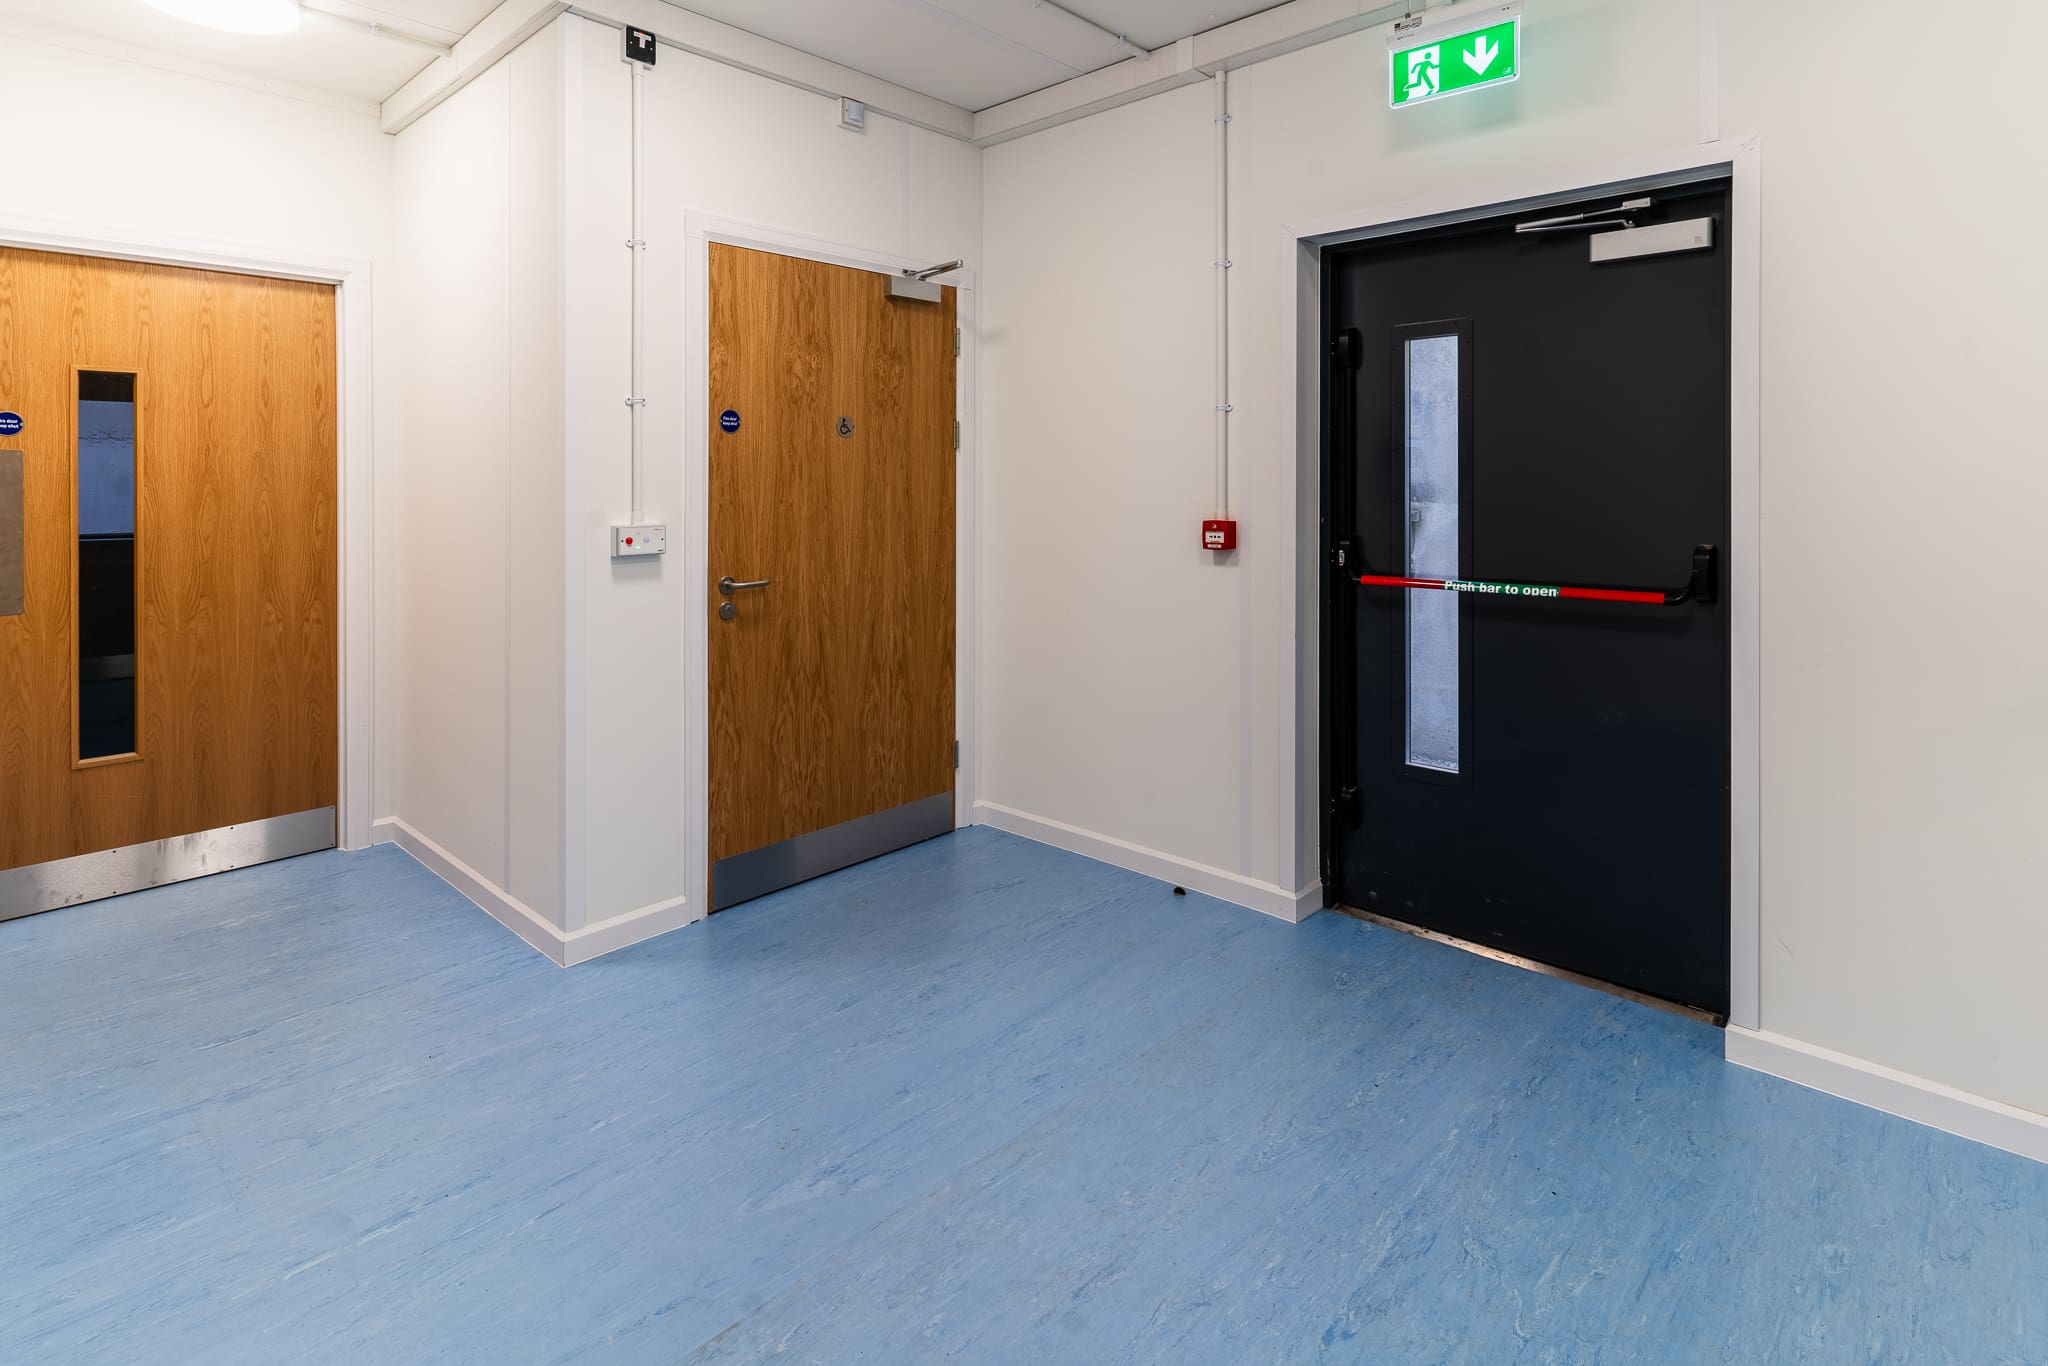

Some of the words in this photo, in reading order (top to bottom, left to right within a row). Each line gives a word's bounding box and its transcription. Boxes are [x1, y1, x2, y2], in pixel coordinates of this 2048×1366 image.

[1444, 581, 1475, 592] Push
[1479, 583, 1501, 594] bar
[1505, 585, 1518, 595] to
[1522, 588, 1557, 598] open
